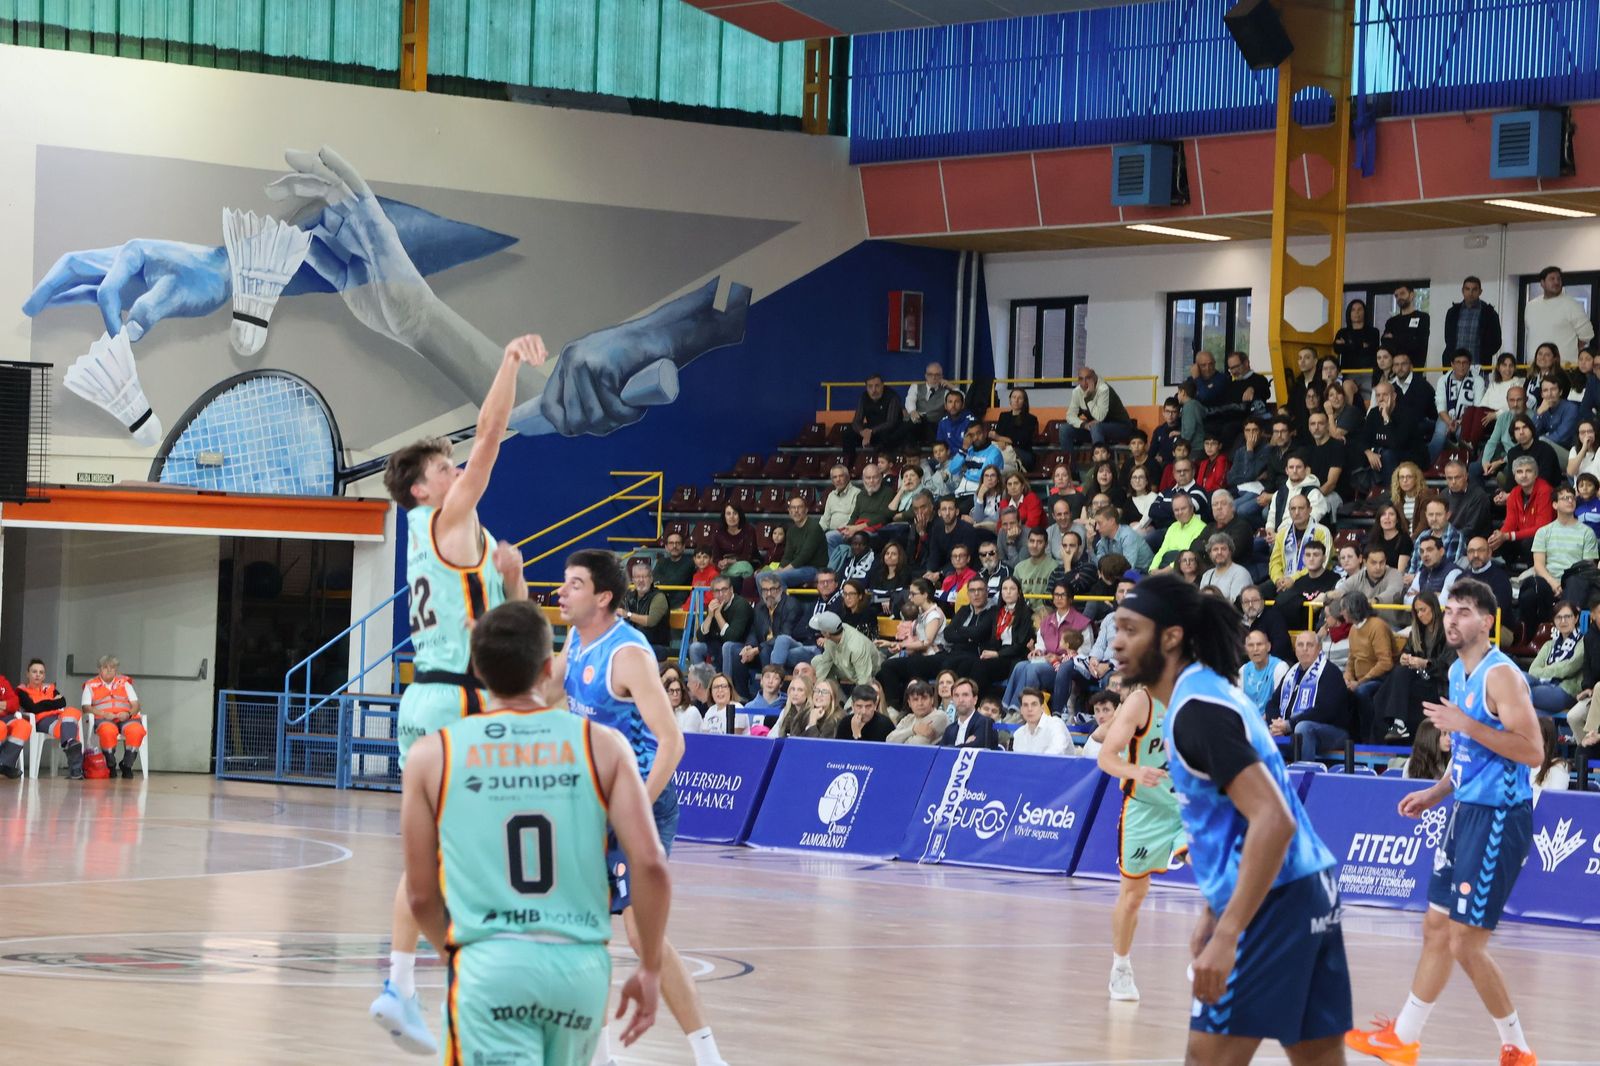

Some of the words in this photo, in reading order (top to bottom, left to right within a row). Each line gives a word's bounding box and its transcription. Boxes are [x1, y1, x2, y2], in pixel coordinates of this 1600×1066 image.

[465, 740, 577, 769] ATENCIA
[671, 771, 742, 791] NIVERSIDAD
[939, 751, 974, 826] ZAMORA
[675, 789, 735, 810] LAMANCA
[1018, 801, 1076, 829] Senda
[799, 831, 843, 849] ZAMORANO
[1014, 825, 1032, 838] Vivir
[506, 813, 555, 895] 0
[1347, 832, 1422, 867] FITECU
[1357, 866, 1398, 879] INTERNACIONAL
[502, 909, 542, 925] THB
[544, 910, 600, 929] hotels
